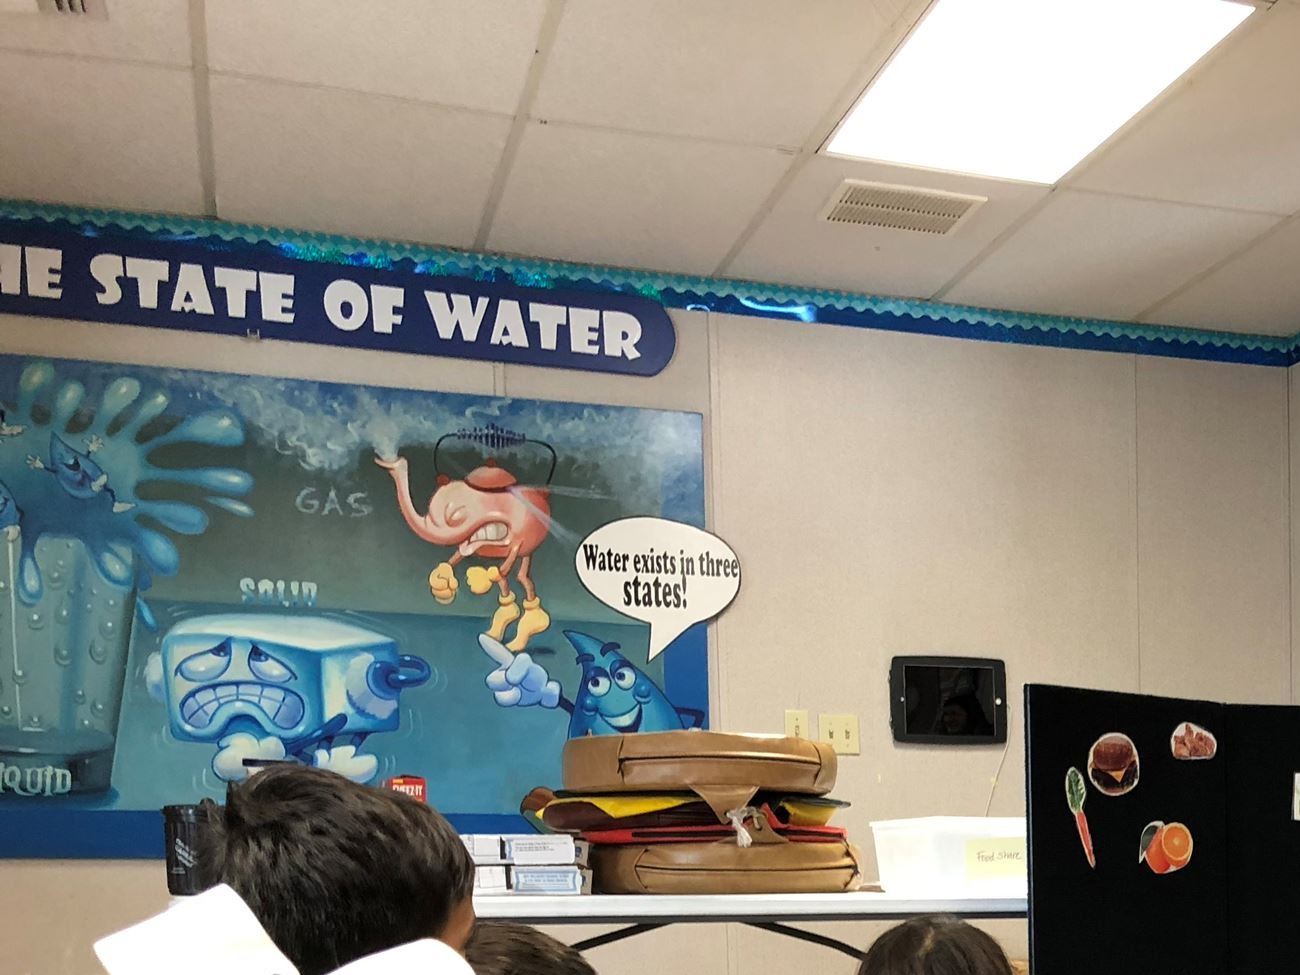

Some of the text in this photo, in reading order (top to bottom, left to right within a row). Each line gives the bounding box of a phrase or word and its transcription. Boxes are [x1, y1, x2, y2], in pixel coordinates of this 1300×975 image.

[89, 253, 295, 323] STATE
[323, 279, 405, 334] OF
[424, 290, 642, 360] WATER
[295, 485, 374, 518] GAS
[583, 544, 739, 578] Water exists in three
[239, 577, 318, 608] SOLID
[623, 574, 687, 609] states!
